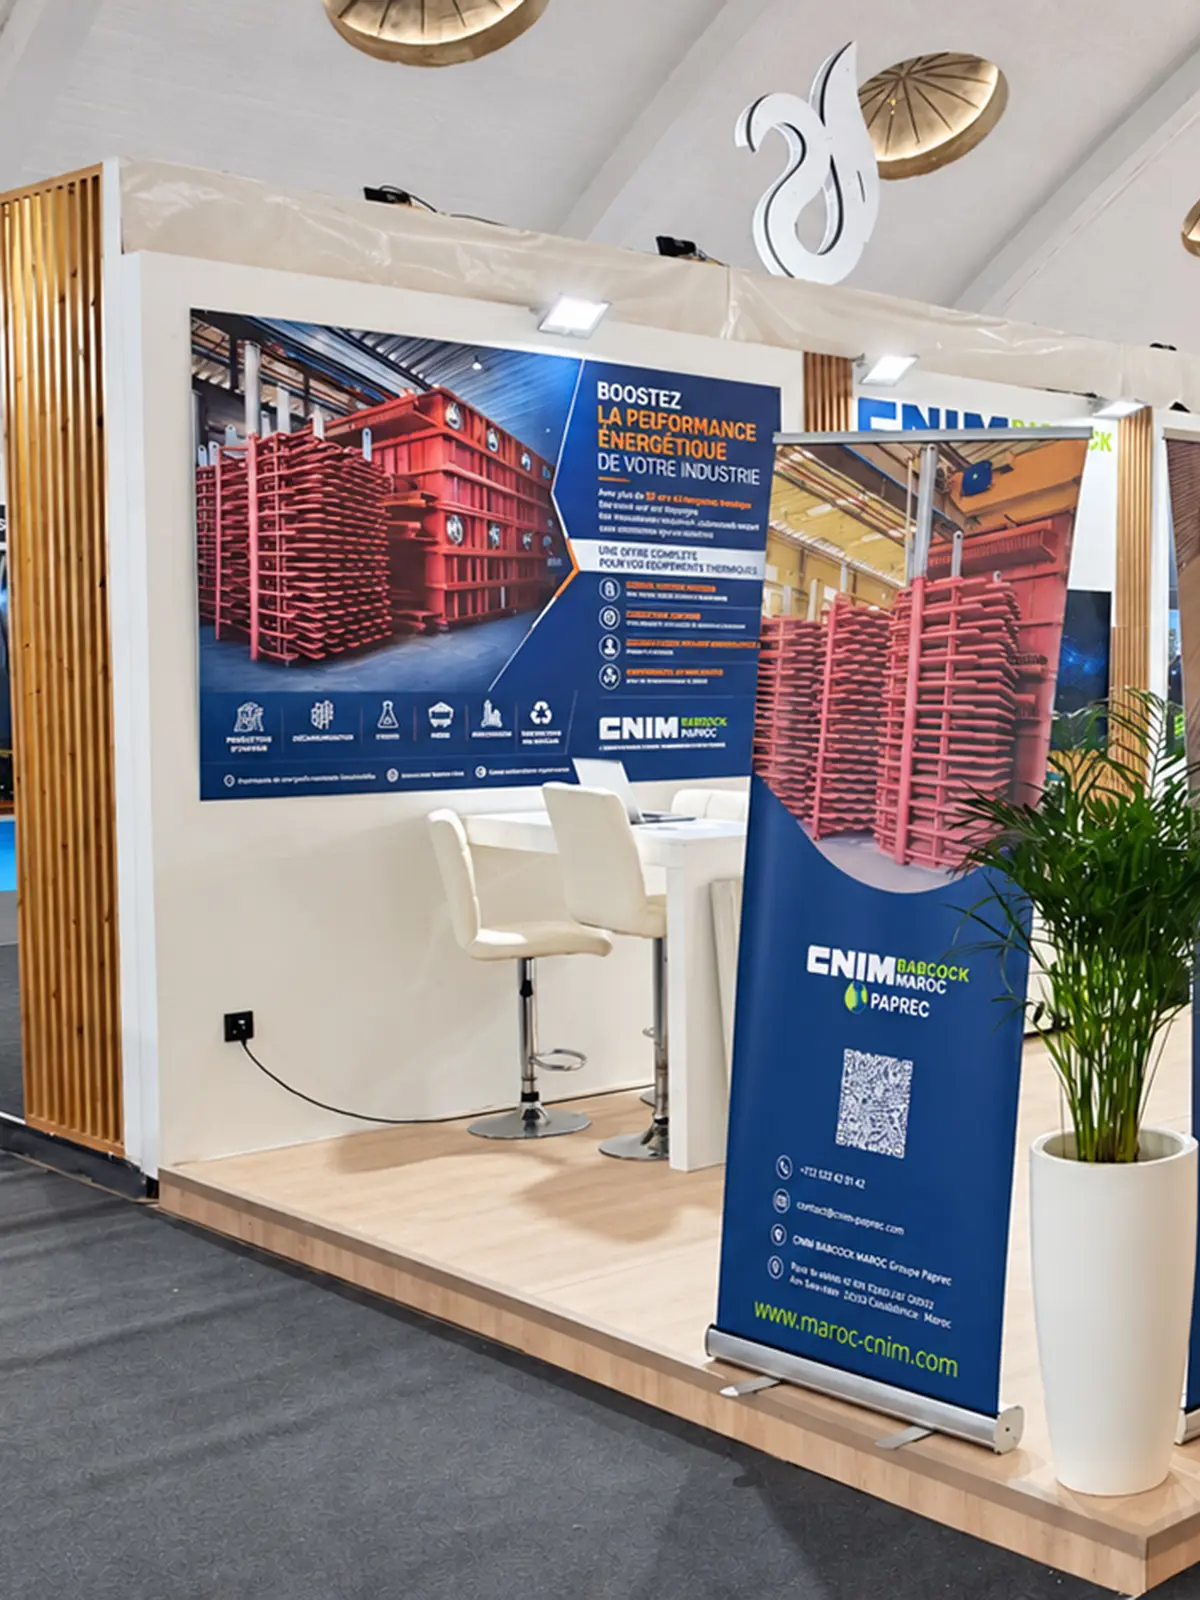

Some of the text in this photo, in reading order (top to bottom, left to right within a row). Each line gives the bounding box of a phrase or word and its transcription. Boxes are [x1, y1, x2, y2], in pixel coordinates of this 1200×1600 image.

[597, 381, 682, 410] BOOSTEZ
[598, 405, 757, 442] LA PERFORMANCE
[598, 424, 727, 460] ÉNERGÉTIQUE
[598, 452, 761, 486] DE VOTRE INDUSTRIE
[599, 716, 679, 740] CNIM
[807, 944, 970, 986] CNIM BABCOCK
[896, 974, 947, 995] MAROC
[870, 992, 930, 1018] PAPREC
[754, 1300, 959, 1378] www.maroc-cnim.com
